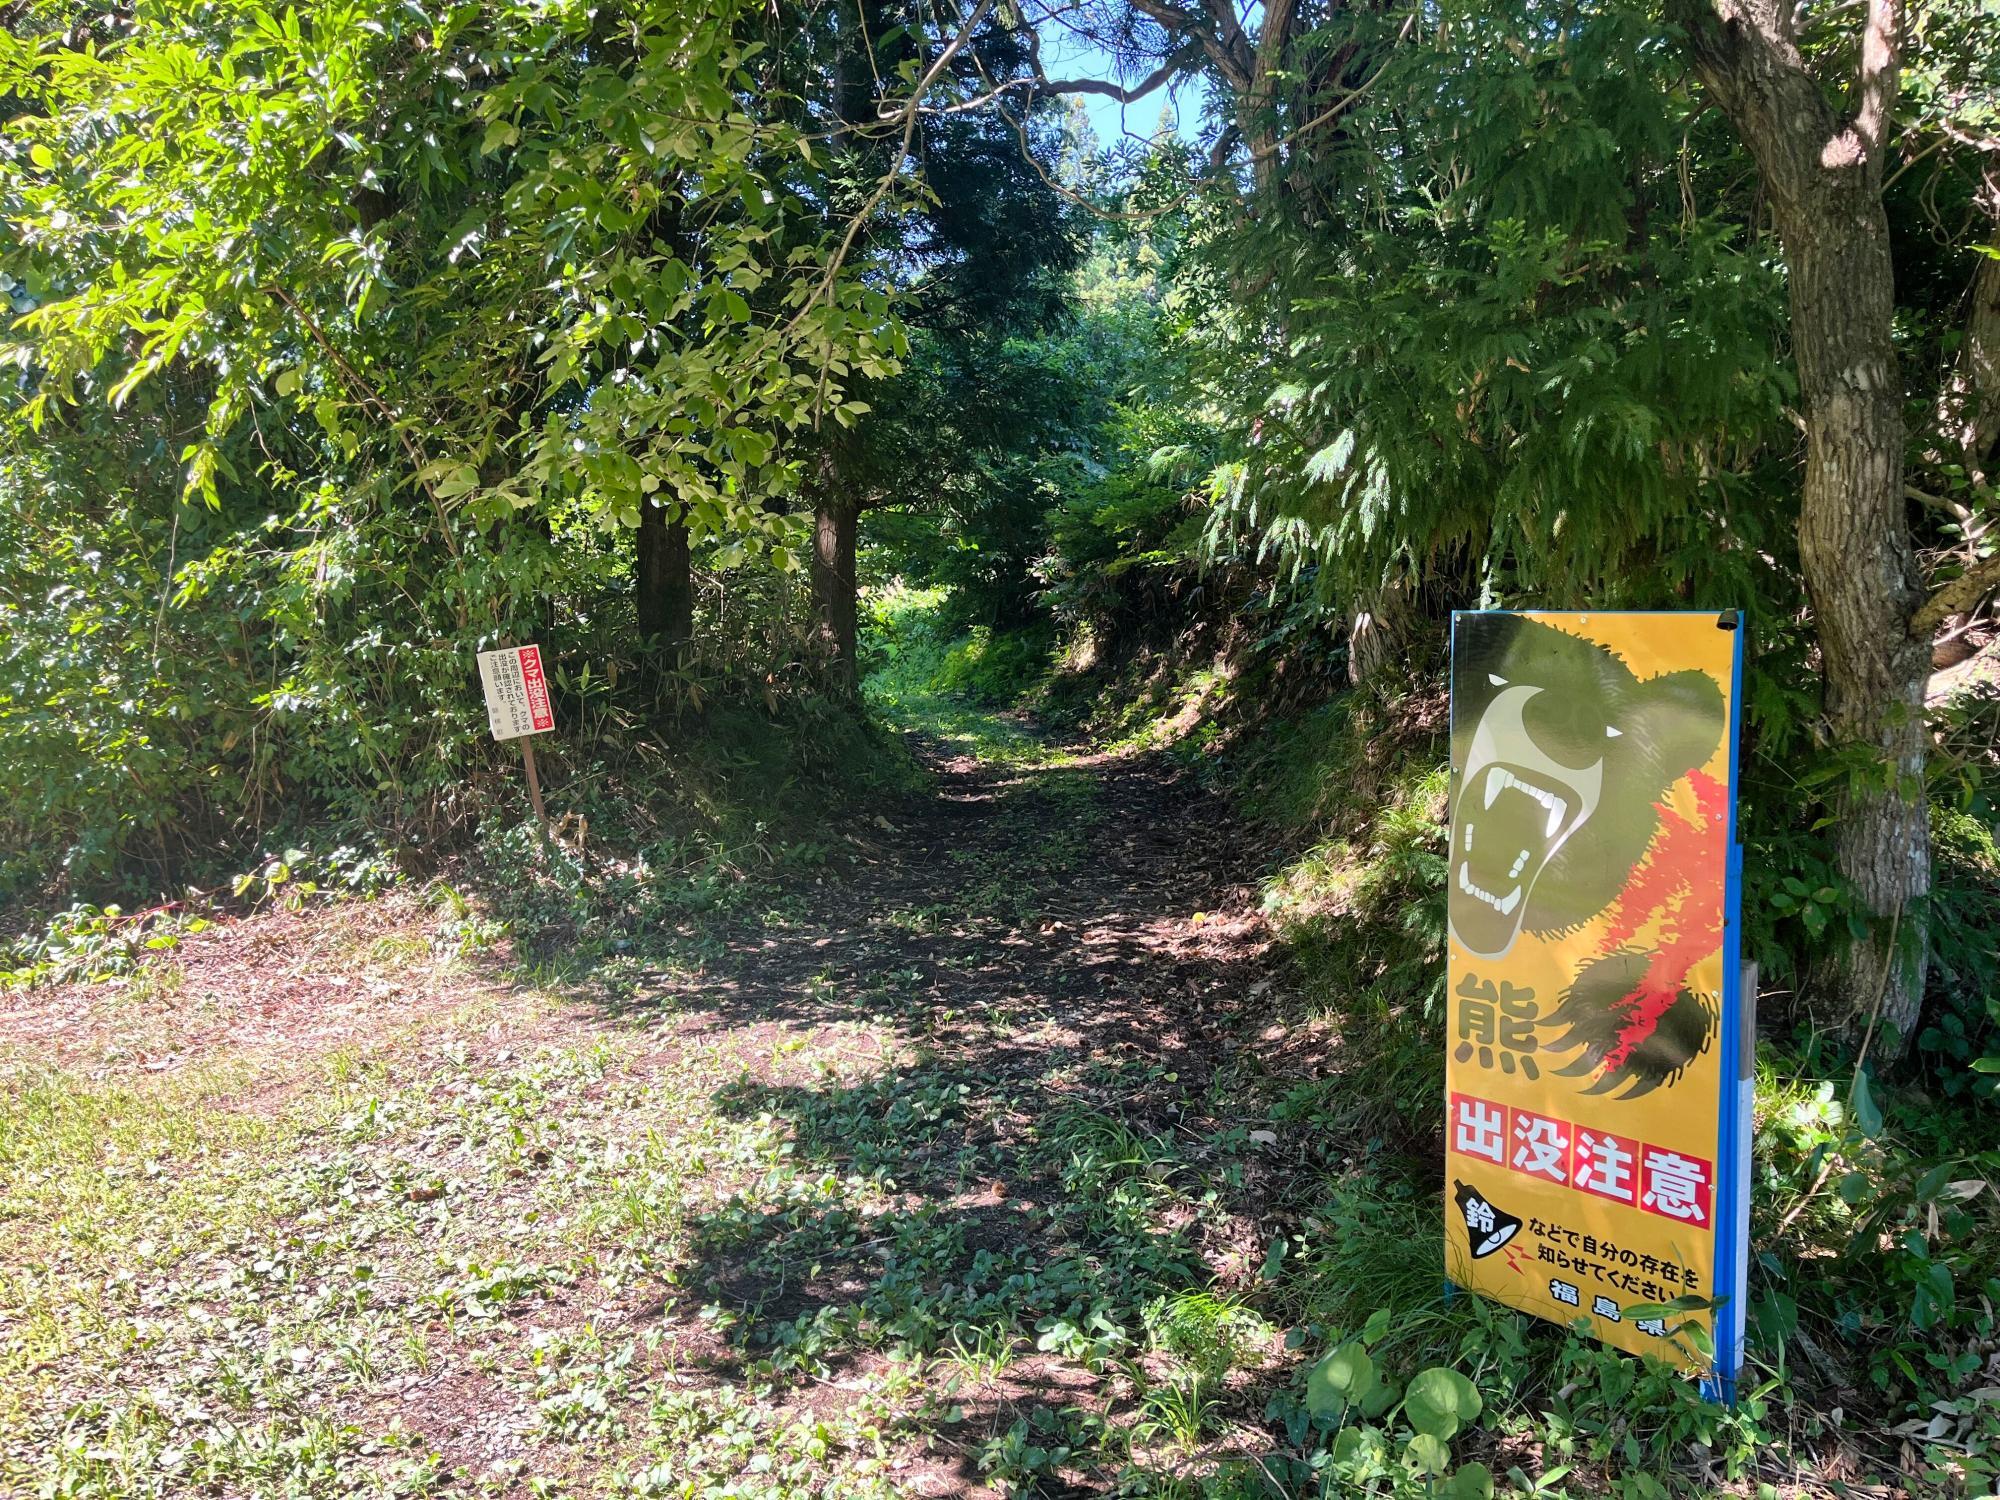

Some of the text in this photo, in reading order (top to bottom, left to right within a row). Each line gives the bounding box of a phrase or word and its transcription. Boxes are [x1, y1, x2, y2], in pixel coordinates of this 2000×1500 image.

[1454, 973, 1540, 1081] 熊
[1456, 1101, 1706, 1221] 出没注意
[1465, 1197, 1496, 1233] 鈴
[1529, 1217, 1699, 1290] などで自分の存在を
